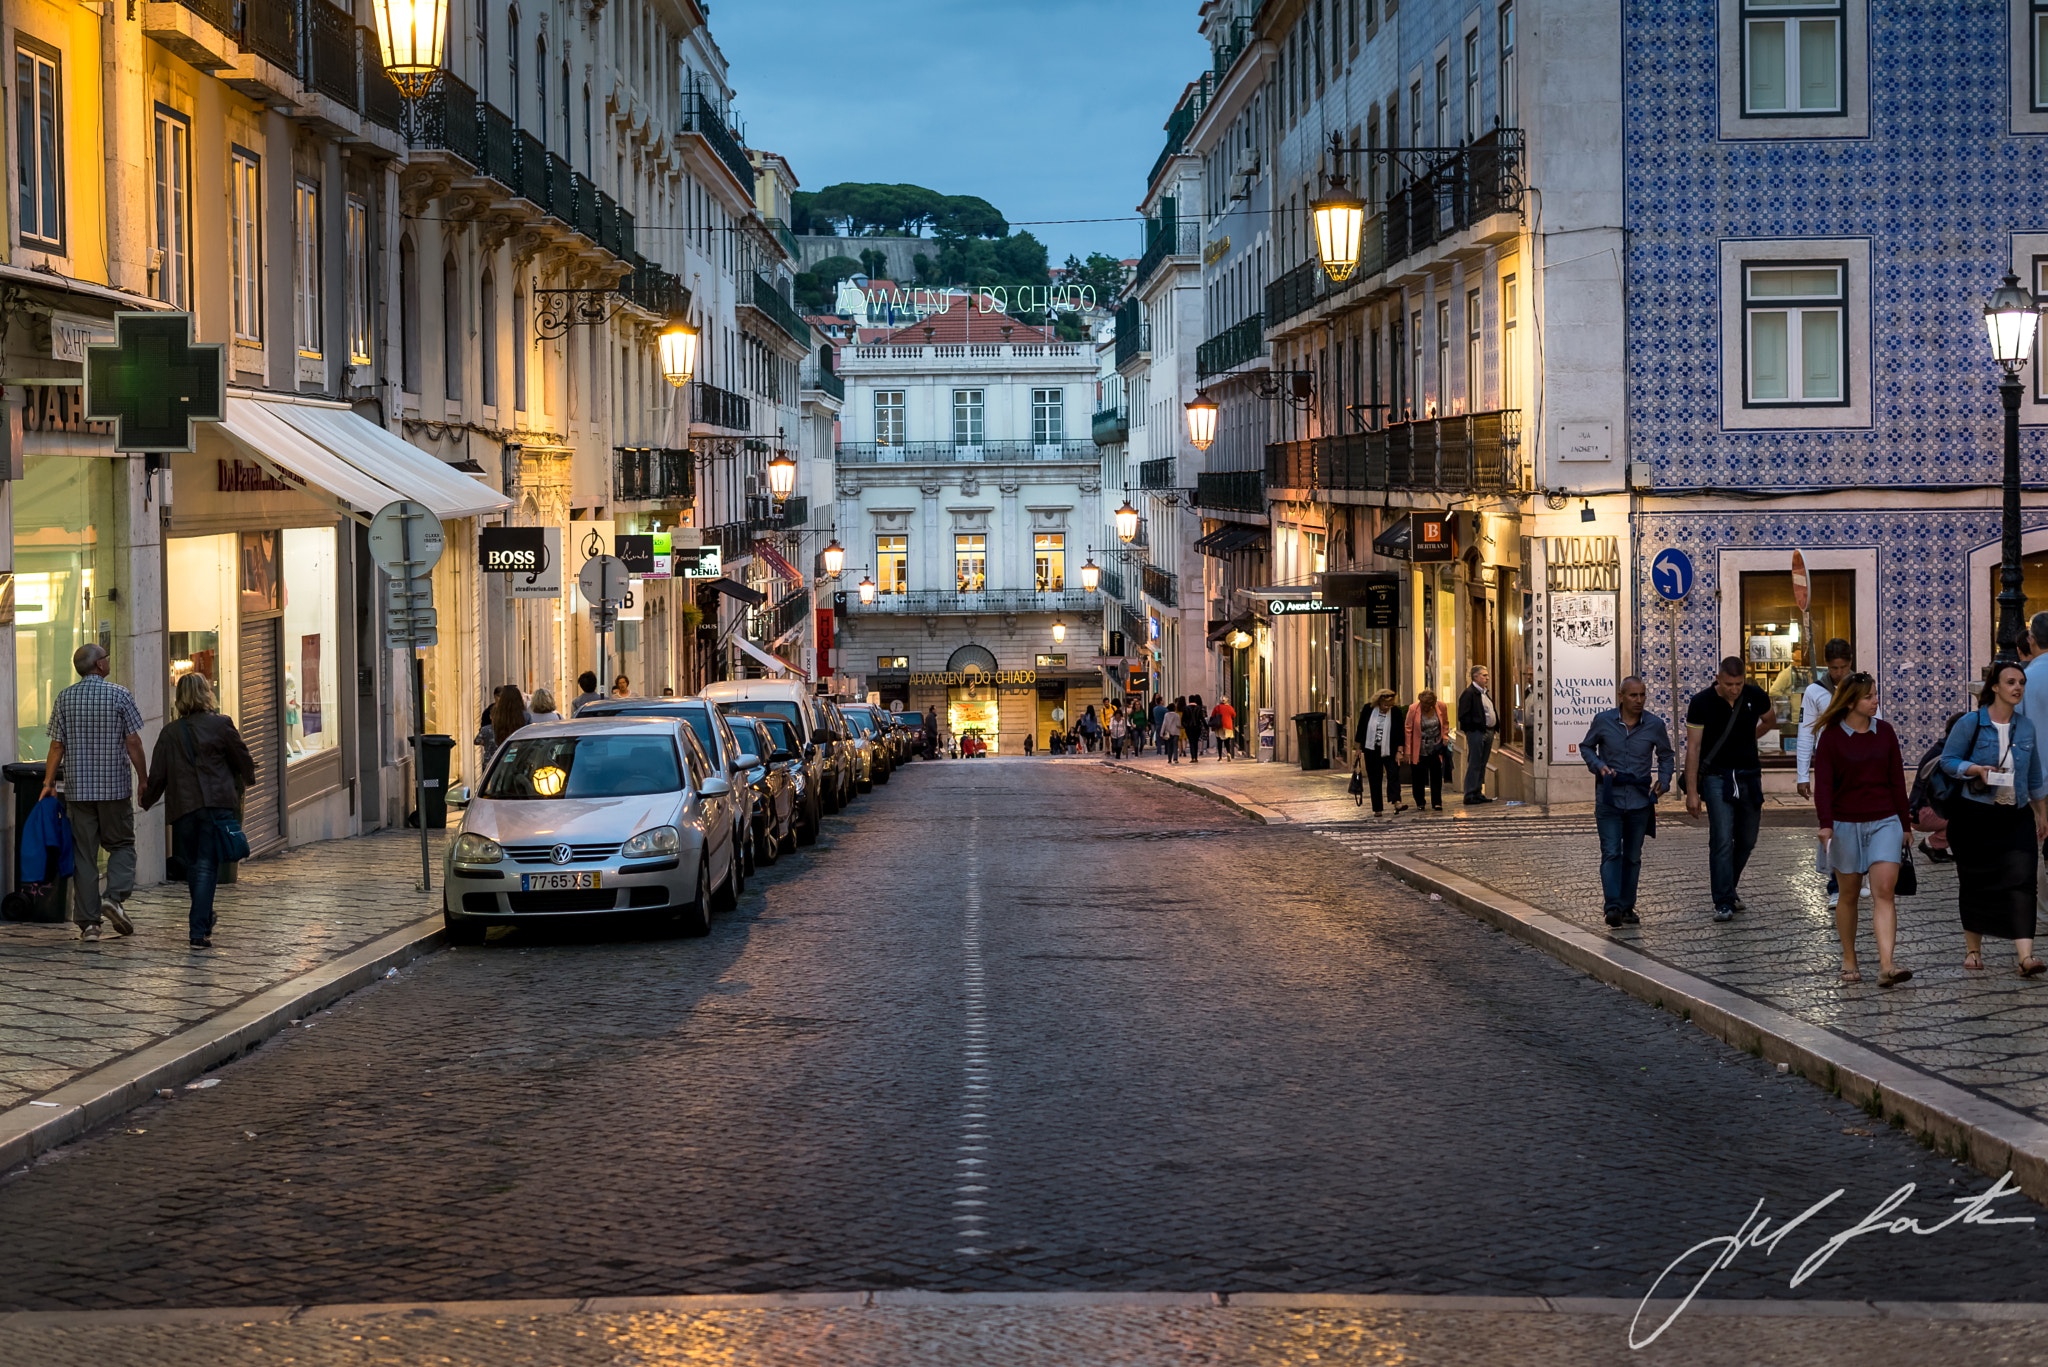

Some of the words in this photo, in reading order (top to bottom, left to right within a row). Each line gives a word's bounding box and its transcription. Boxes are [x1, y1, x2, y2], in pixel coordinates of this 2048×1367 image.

[837, 287, 954, 315] ARMAZENS
[979, 286, 1008, 314] DO
[1018, 285, 1097, 313] CHIADO
[1427, 524, 1439, 538] B
[488, 550, 536, 565] BOSS
[691, 568, 720, 576] DENIA
[909, 671, 966, 686] ARMAZENS
[974, 671, 991, 685] DO
[995, 670, 1036, 684] CHIADO
[1555, 678, 1564, 689] A
[1565, 678, 1614, 688] LIVRARIA
[1537, 679, 1543, 701] EM
[1553, 687, 1581, 698] MAIS
[1570, 696, 1613, 706] ANTIGA
[1554, 707, 1570, 715] DO
